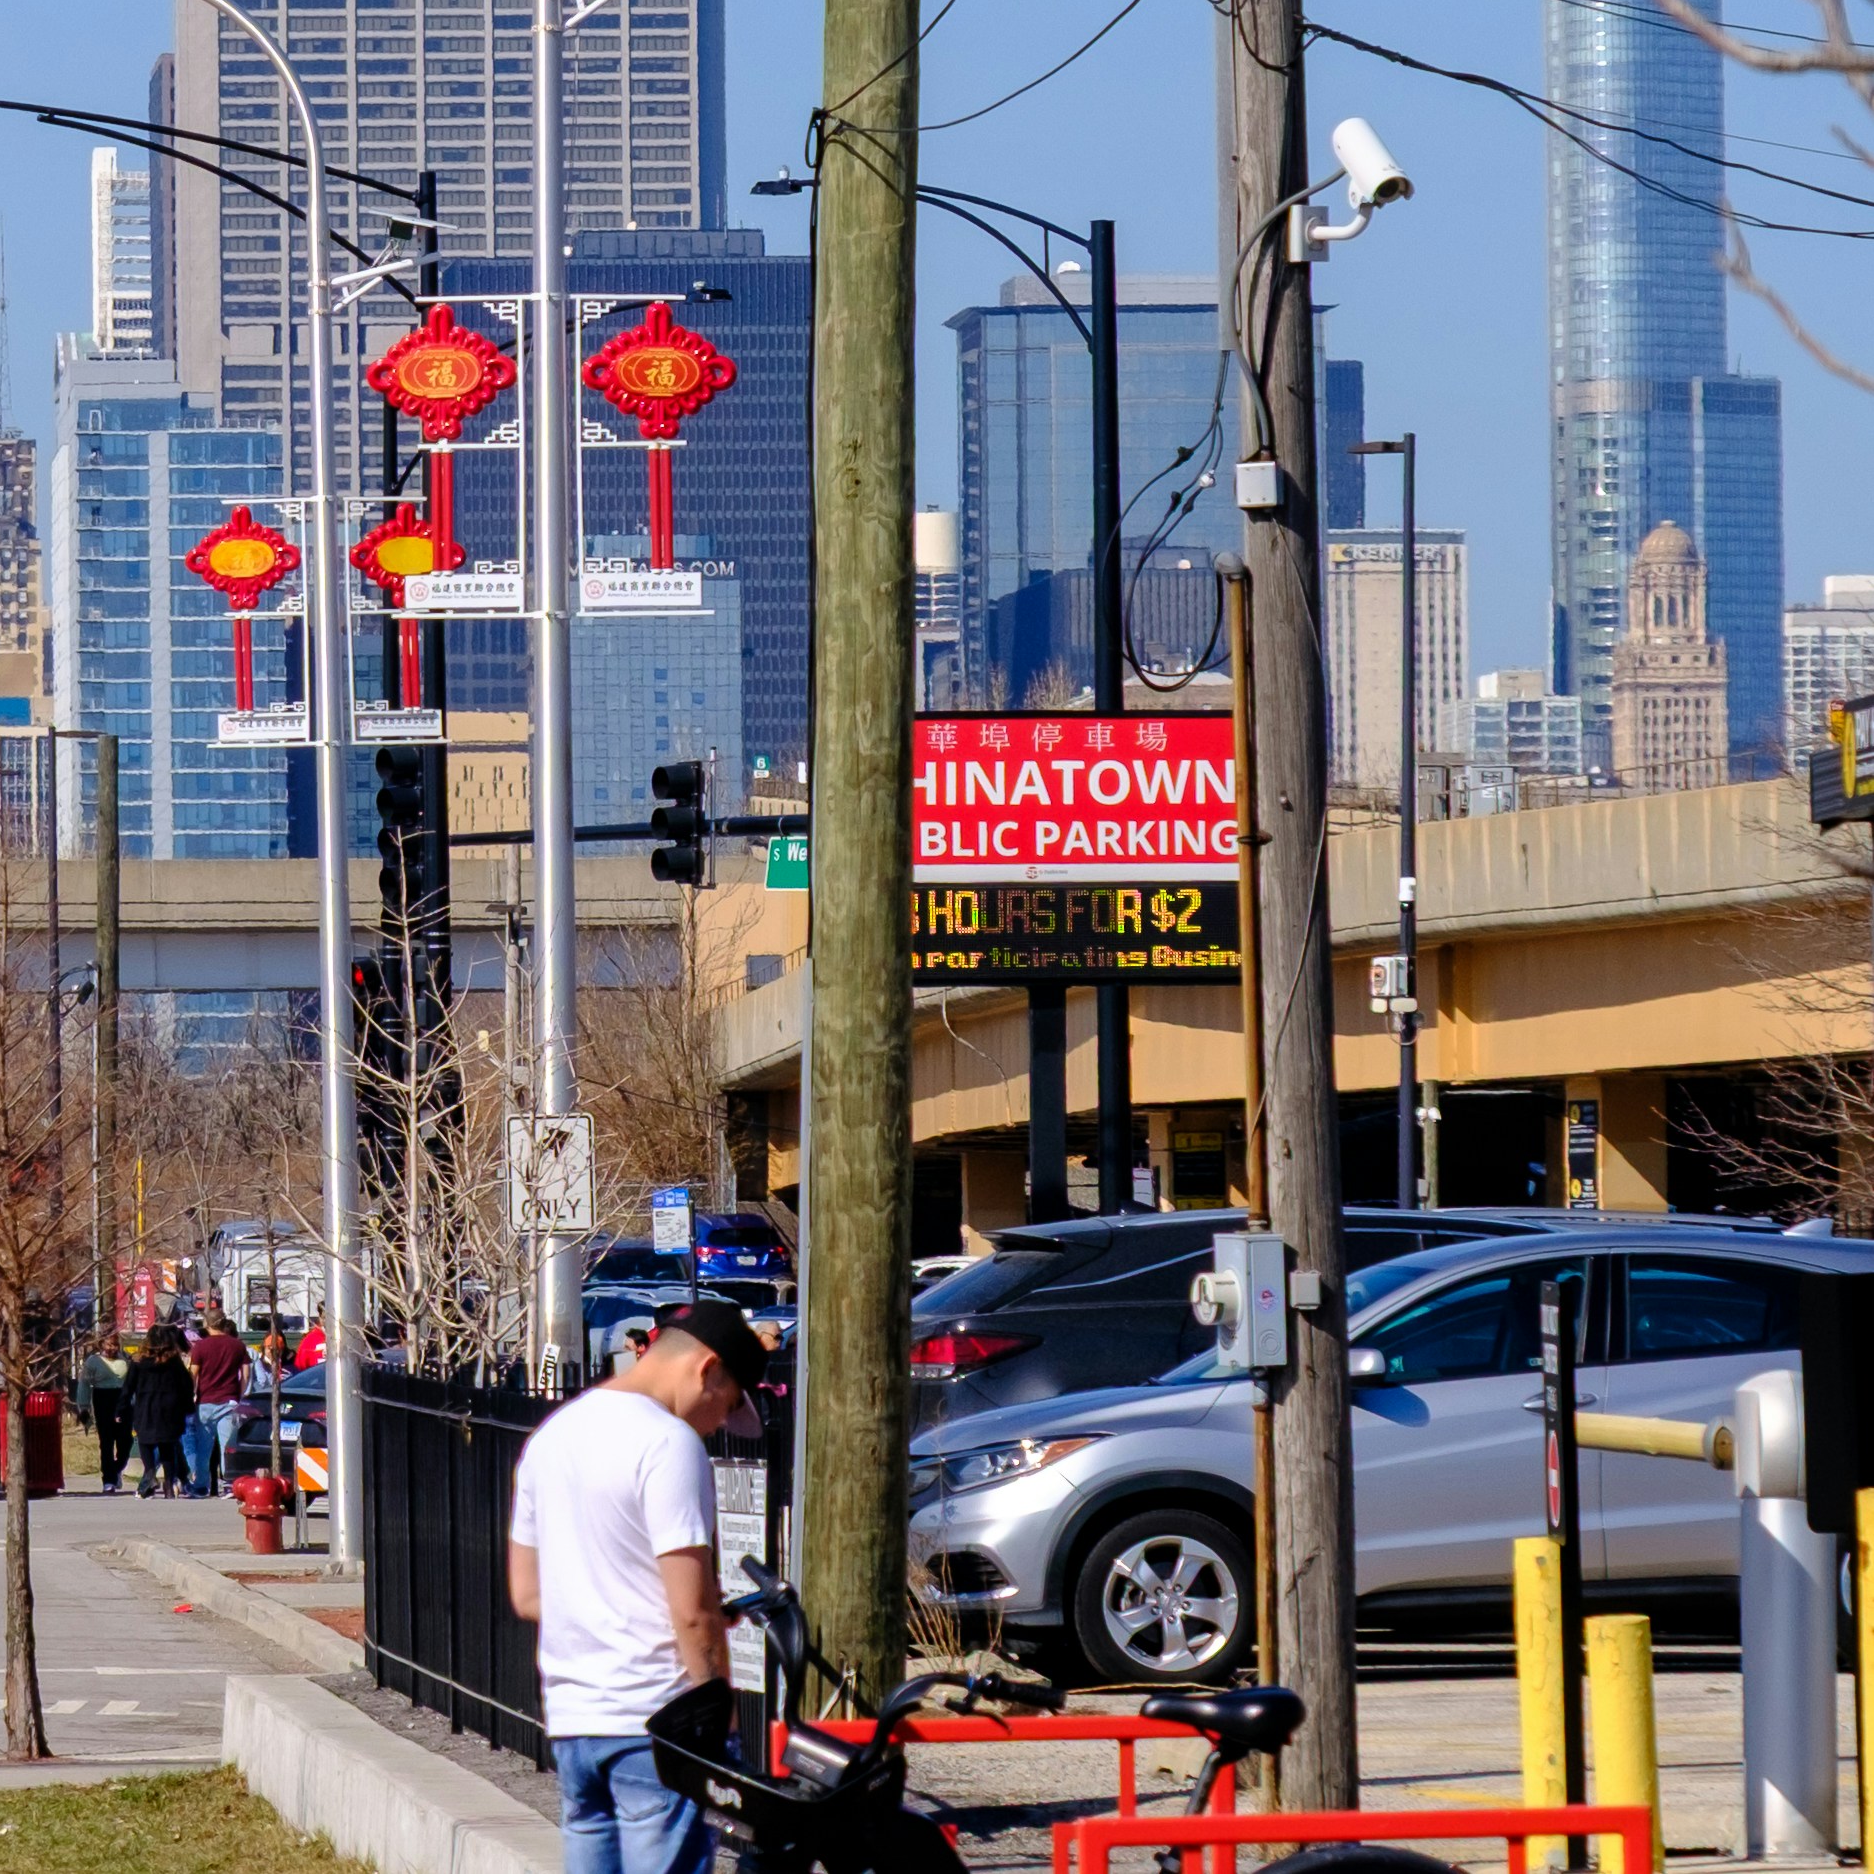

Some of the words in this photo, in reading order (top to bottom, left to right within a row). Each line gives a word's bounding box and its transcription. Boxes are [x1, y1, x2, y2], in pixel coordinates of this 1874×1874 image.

[425, 360, 457, 387] 福
[644, 359, 676, 387] 福
[926, 722, 1168, 754] 華埠停車場
[913, 759, 1236, 806] HINATOWN
[773, 847, 780, 862] S
[787, 842, 808, 862] We
[919, 821, 1019, 858] BLIC
[1035, 820, 1239, 857] PARKING
[927, 889, 1056, 934] HOURS
[1065, 888, 1142, 934] FOR
[1150, 888, 1202, 933] $2
[521, 1198, 582, 1219] ONLY
[705, 1778, 742, 1810] lyft
